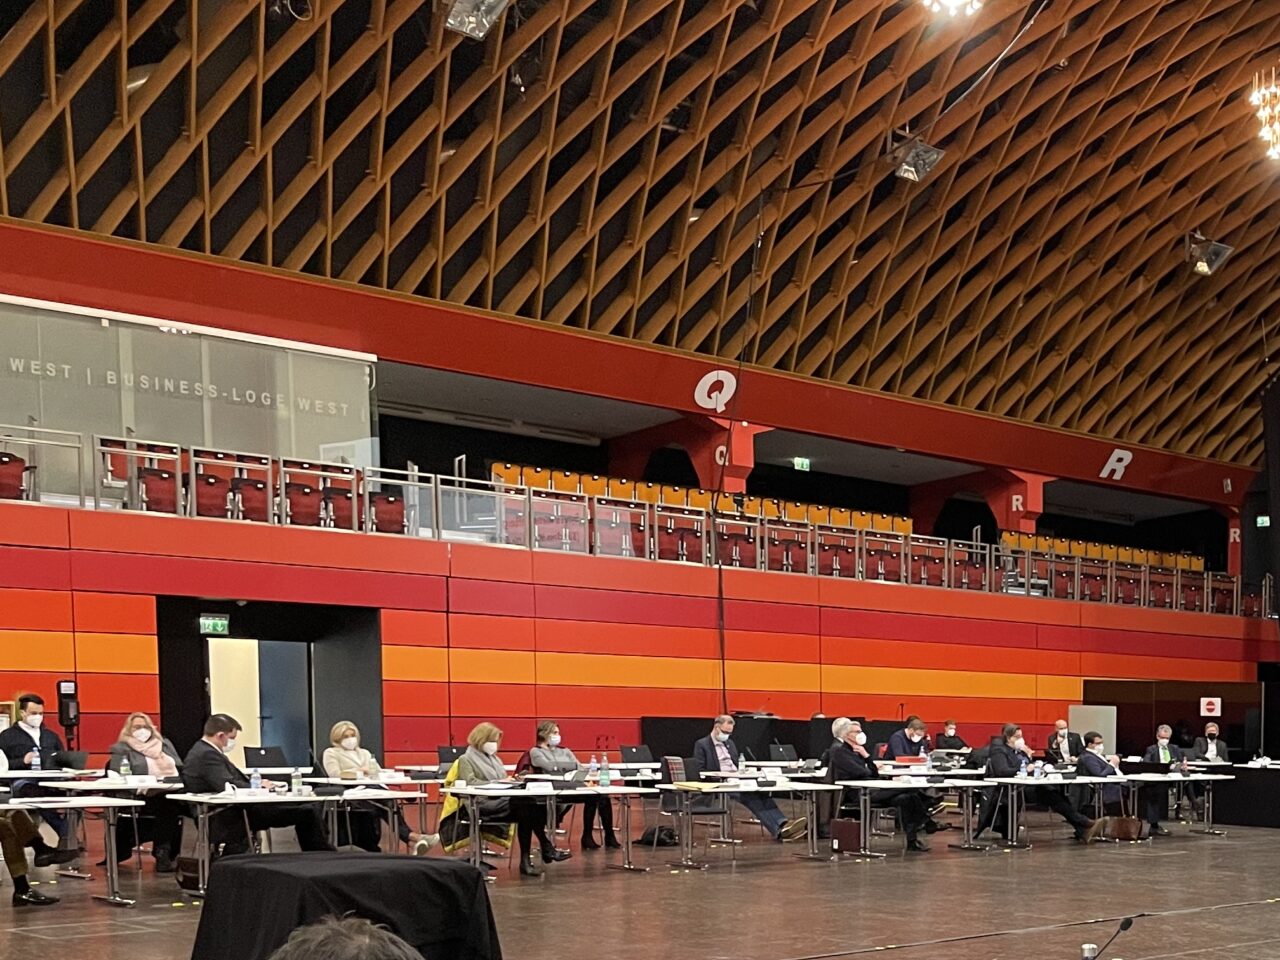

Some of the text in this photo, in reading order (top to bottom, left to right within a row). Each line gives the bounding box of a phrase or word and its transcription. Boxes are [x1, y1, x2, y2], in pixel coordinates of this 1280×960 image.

[9, 357, 350, 417] WEST BUSINESS-LOGE WEST
[694, 369, 737, 414] Q
[1098, 448, 1133, 481] R
[1011, 494, 1025, 512] R
[1229, 527, 1241, 543] R
